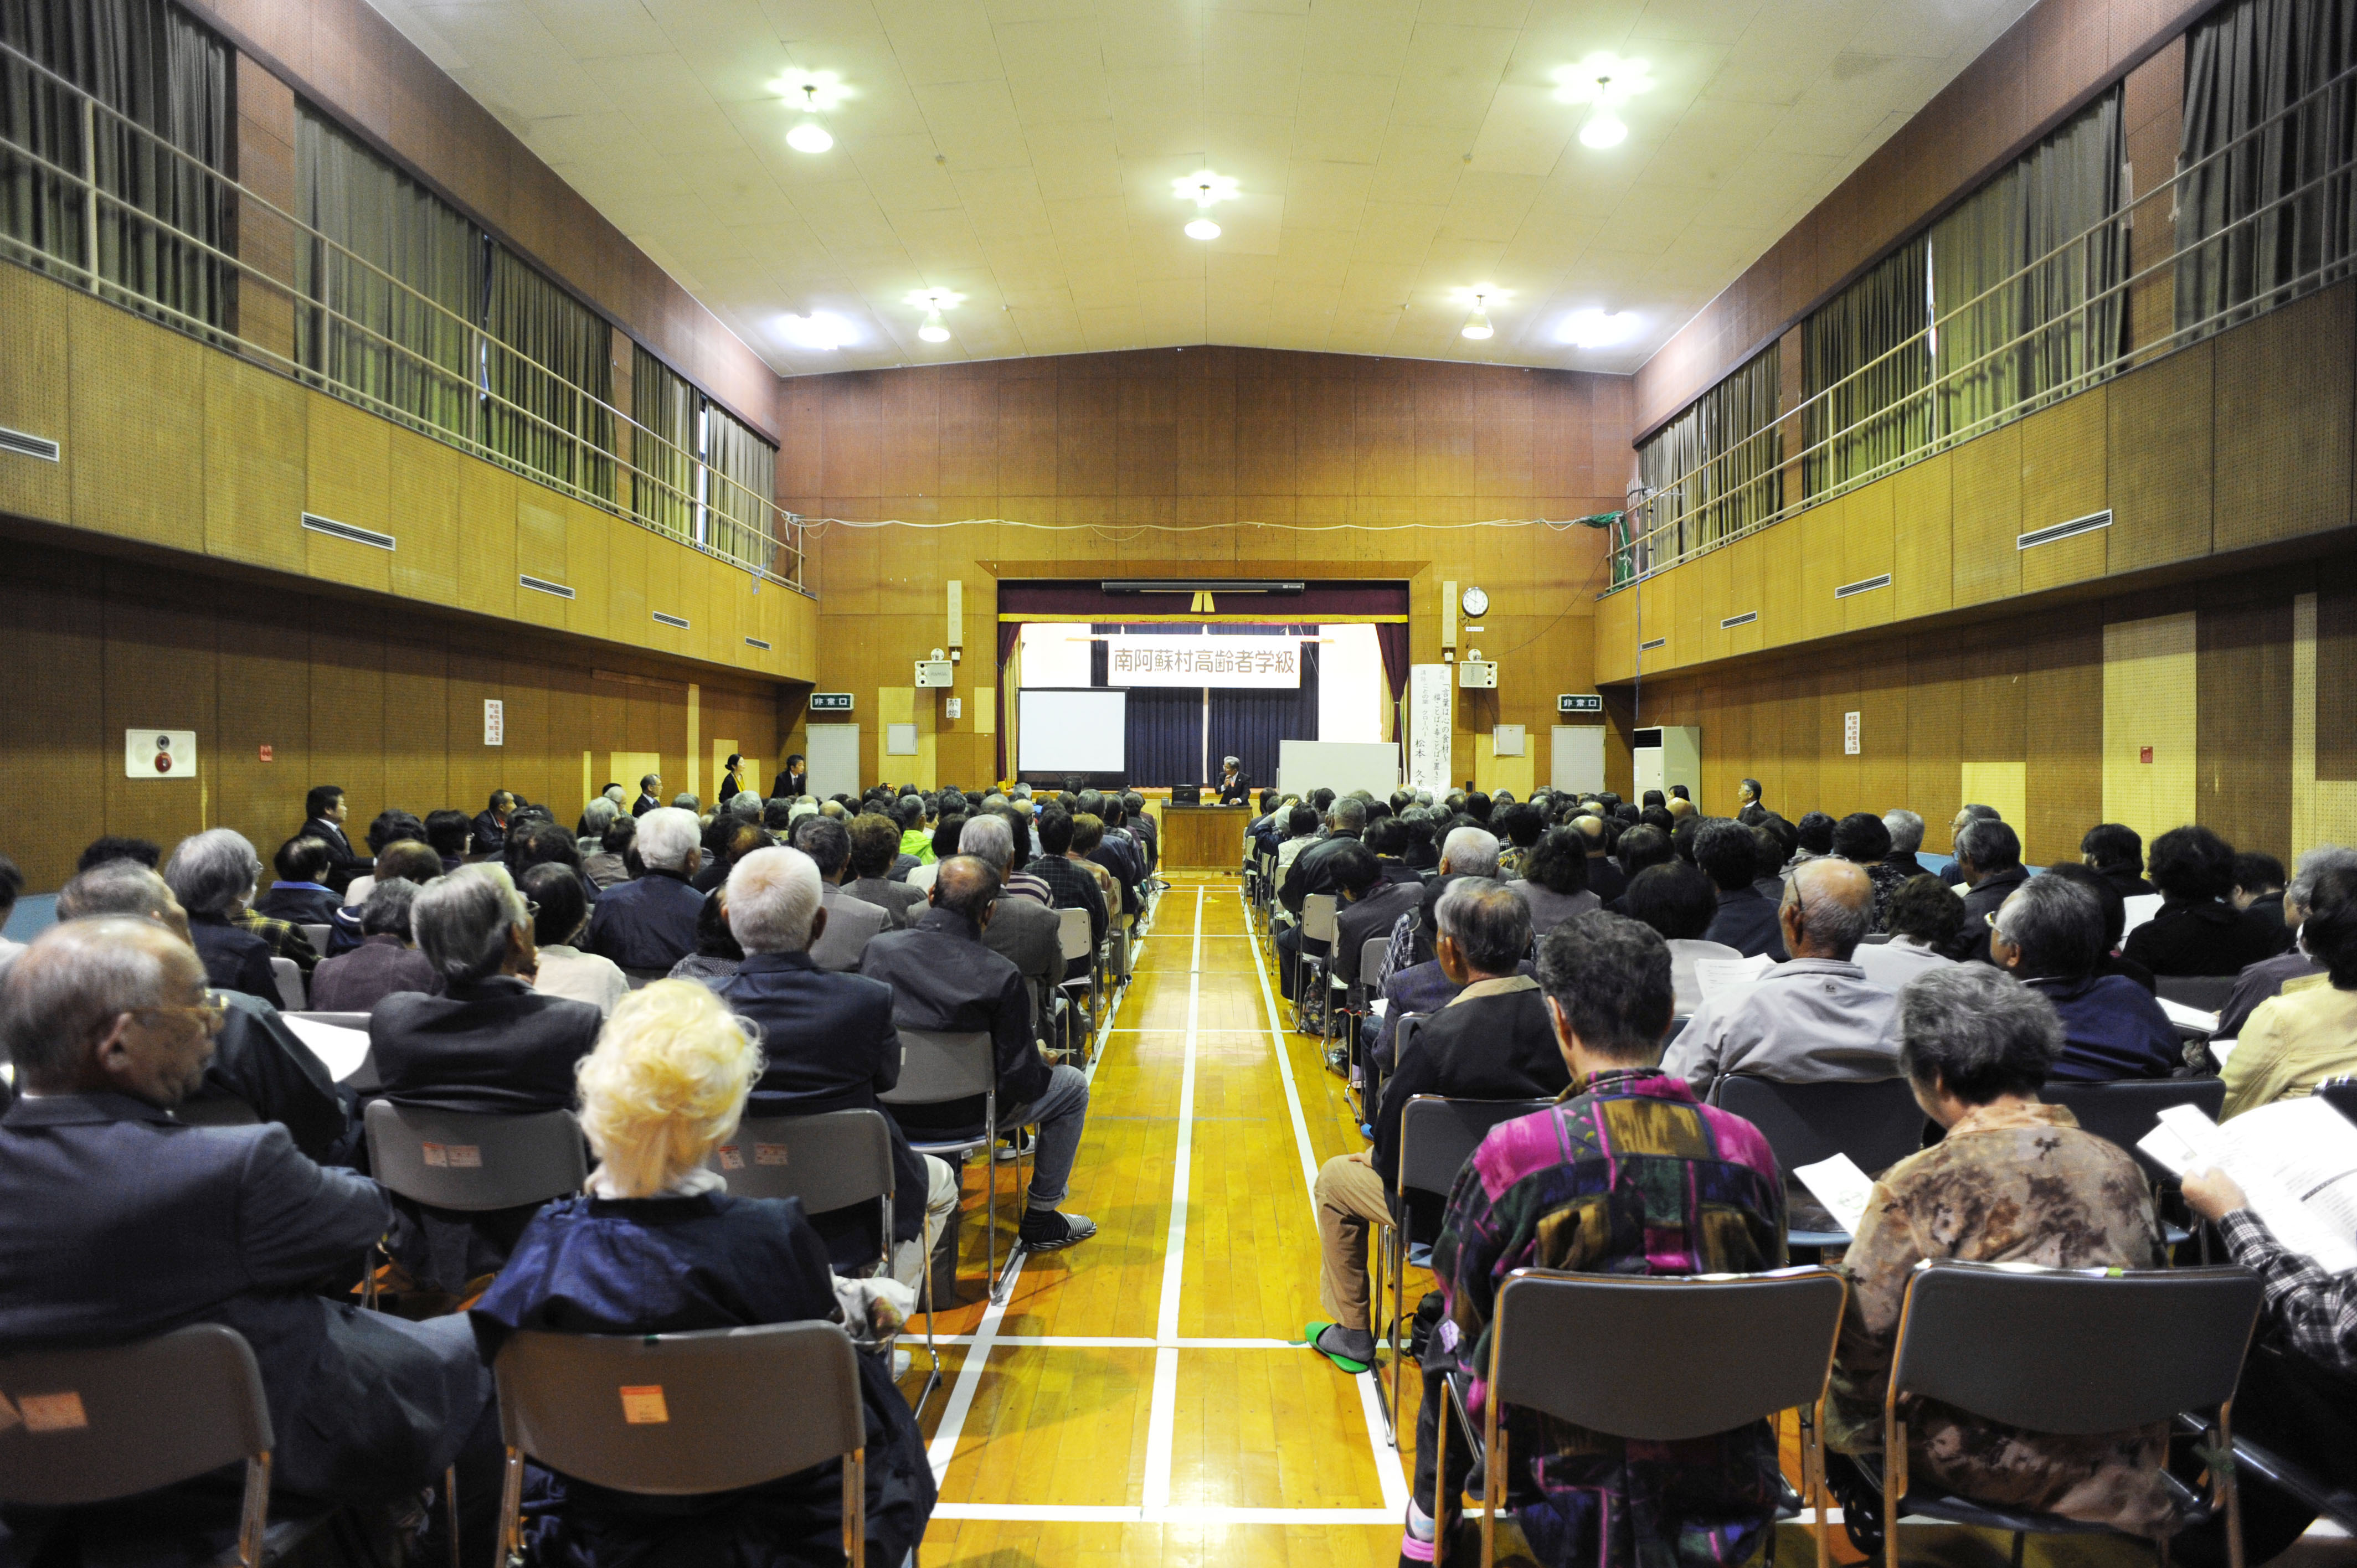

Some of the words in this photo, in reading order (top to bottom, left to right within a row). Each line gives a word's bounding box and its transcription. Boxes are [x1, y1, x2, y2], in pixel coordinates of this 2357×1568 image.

[1114, 648, 1294, 674] 南阿蘇村高齢者学級
[1563, 699, 1597, 707] 非常口
[1415, 739, 1426, 758] 松本
